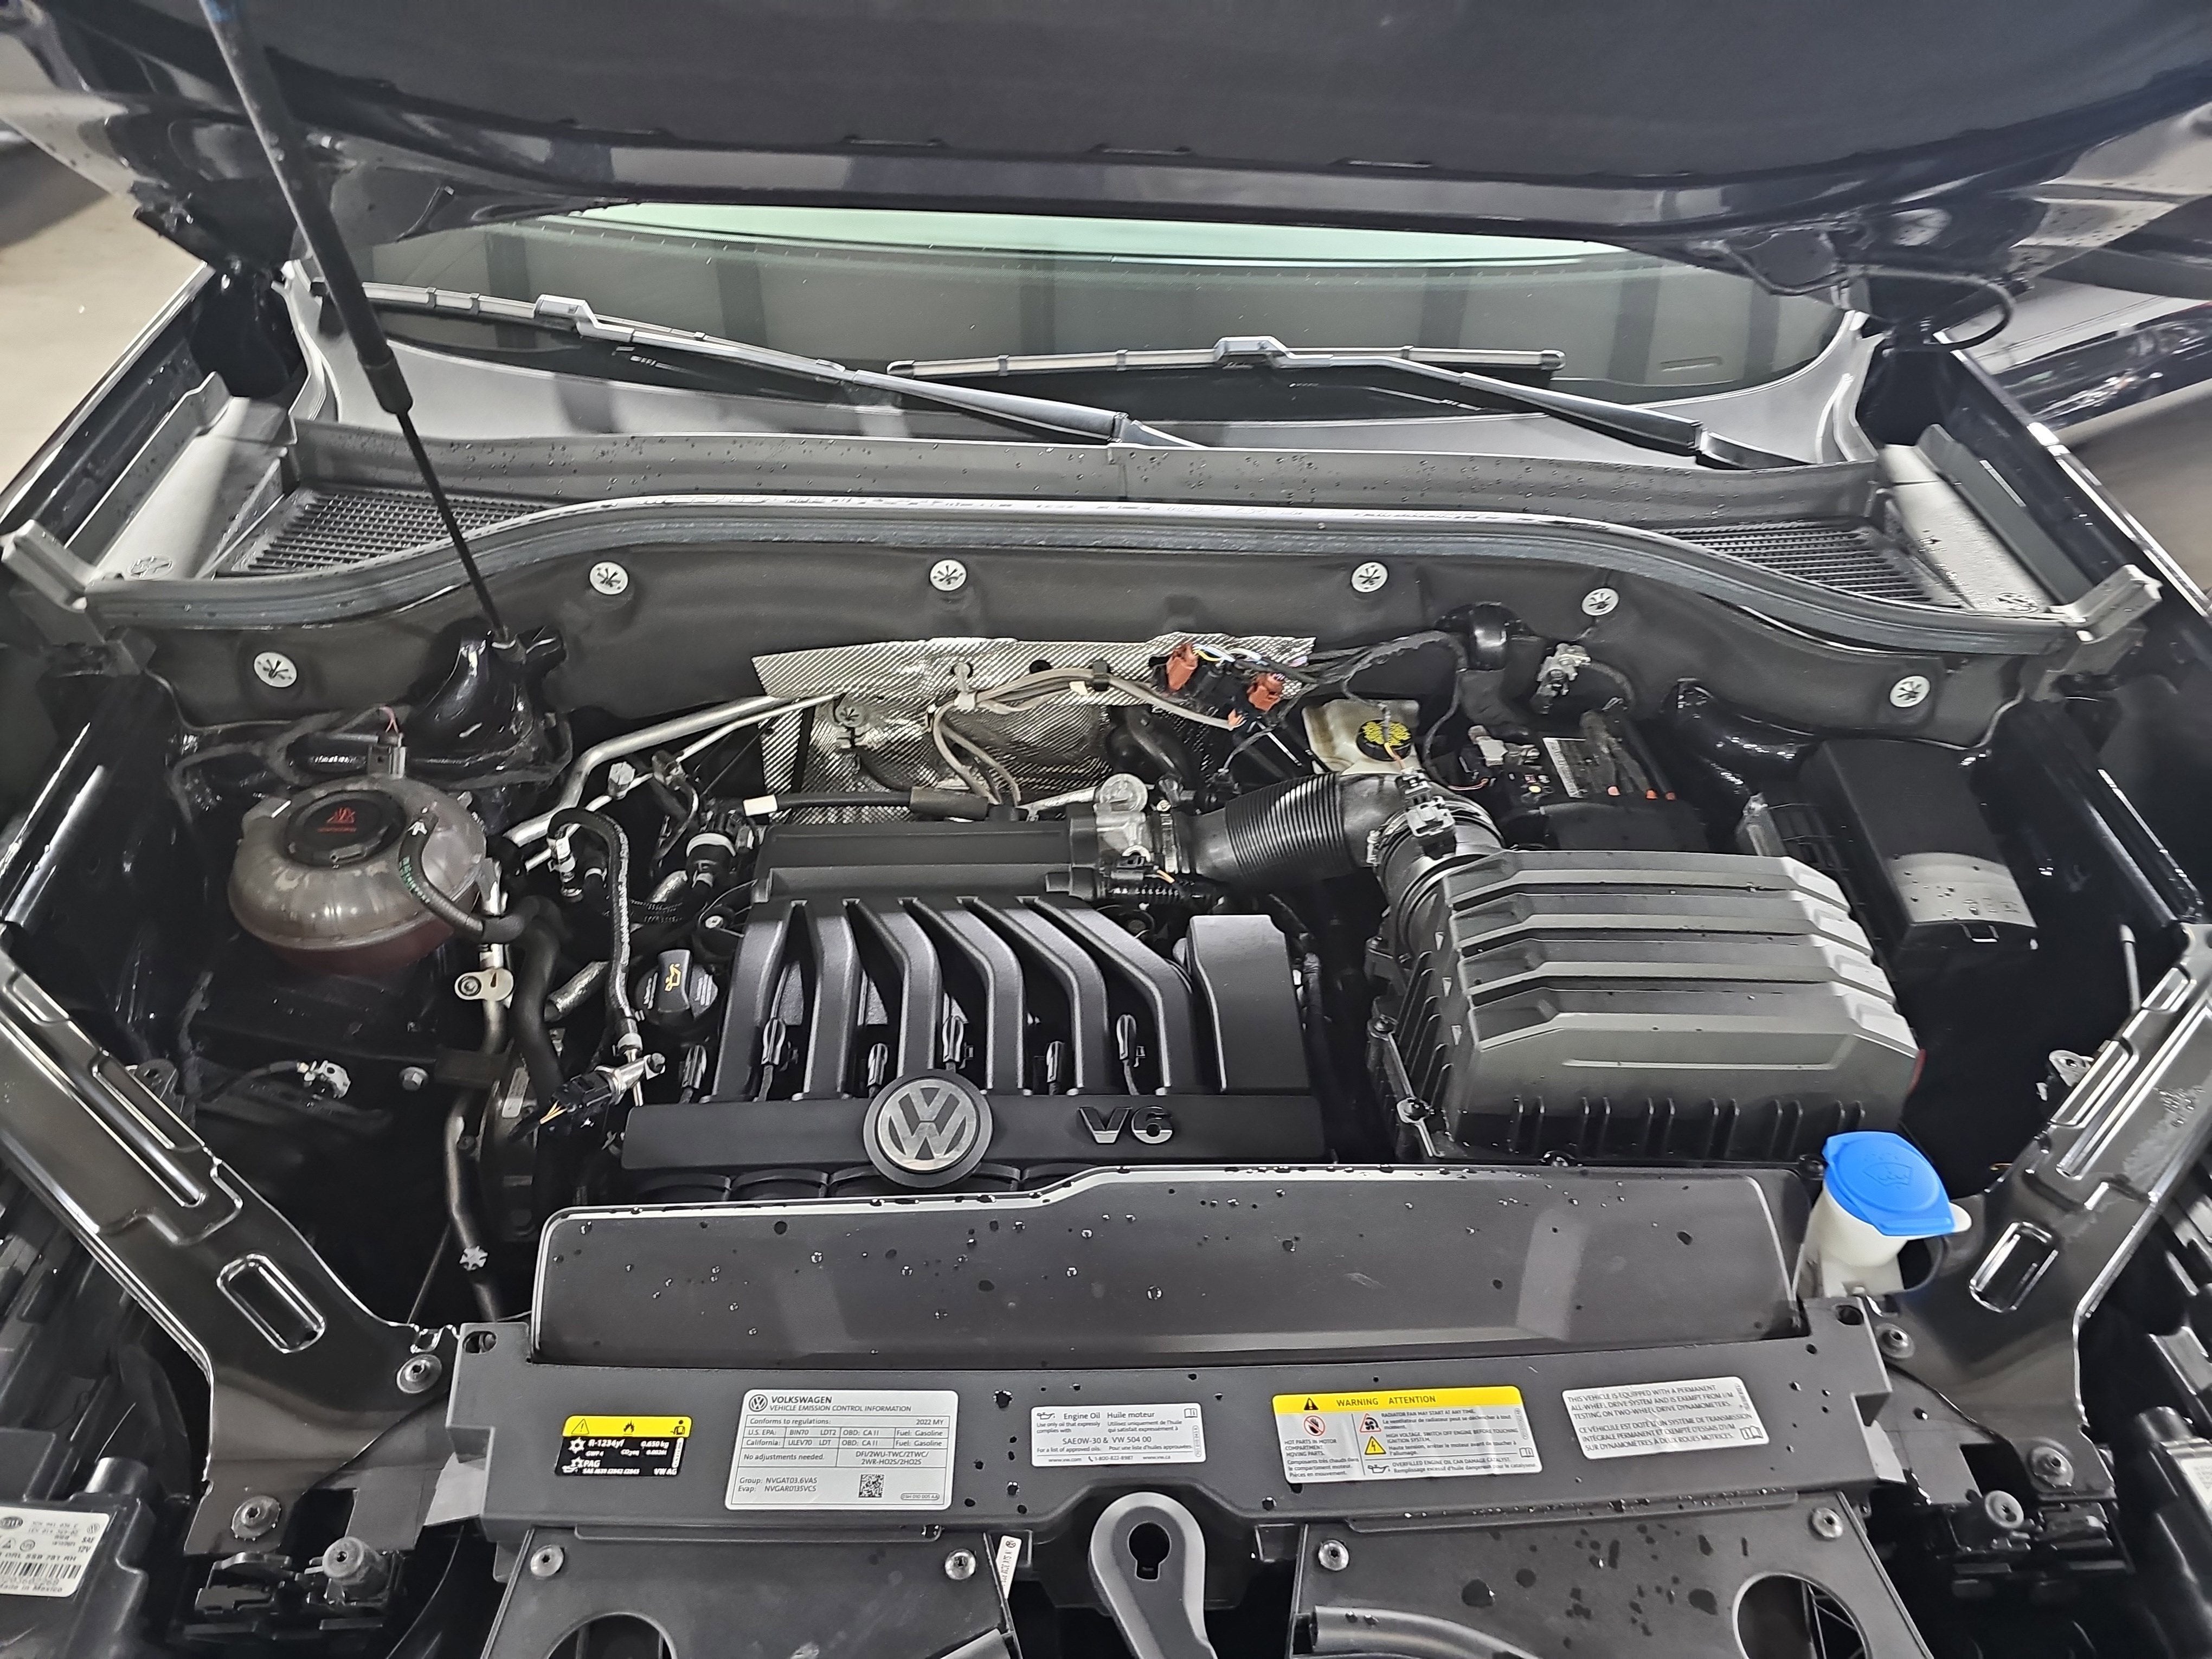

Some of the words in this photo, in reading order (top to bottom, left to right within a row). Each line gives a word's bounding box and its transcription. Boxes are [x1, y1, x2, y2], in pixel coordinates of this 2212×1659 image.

[1078, 1105, 1174, 1144] V6
[1619, 1390, 1651, 1398] EQUIPPED
[1677, 1385, 1716, 1393] PERMANENT
[1336, 1398, 1378, 1406] WARNING
[1389, 1396, 1436, 1404] ATTENTION
[1705, 1413, 1752, 1422] TRANSMISSION
